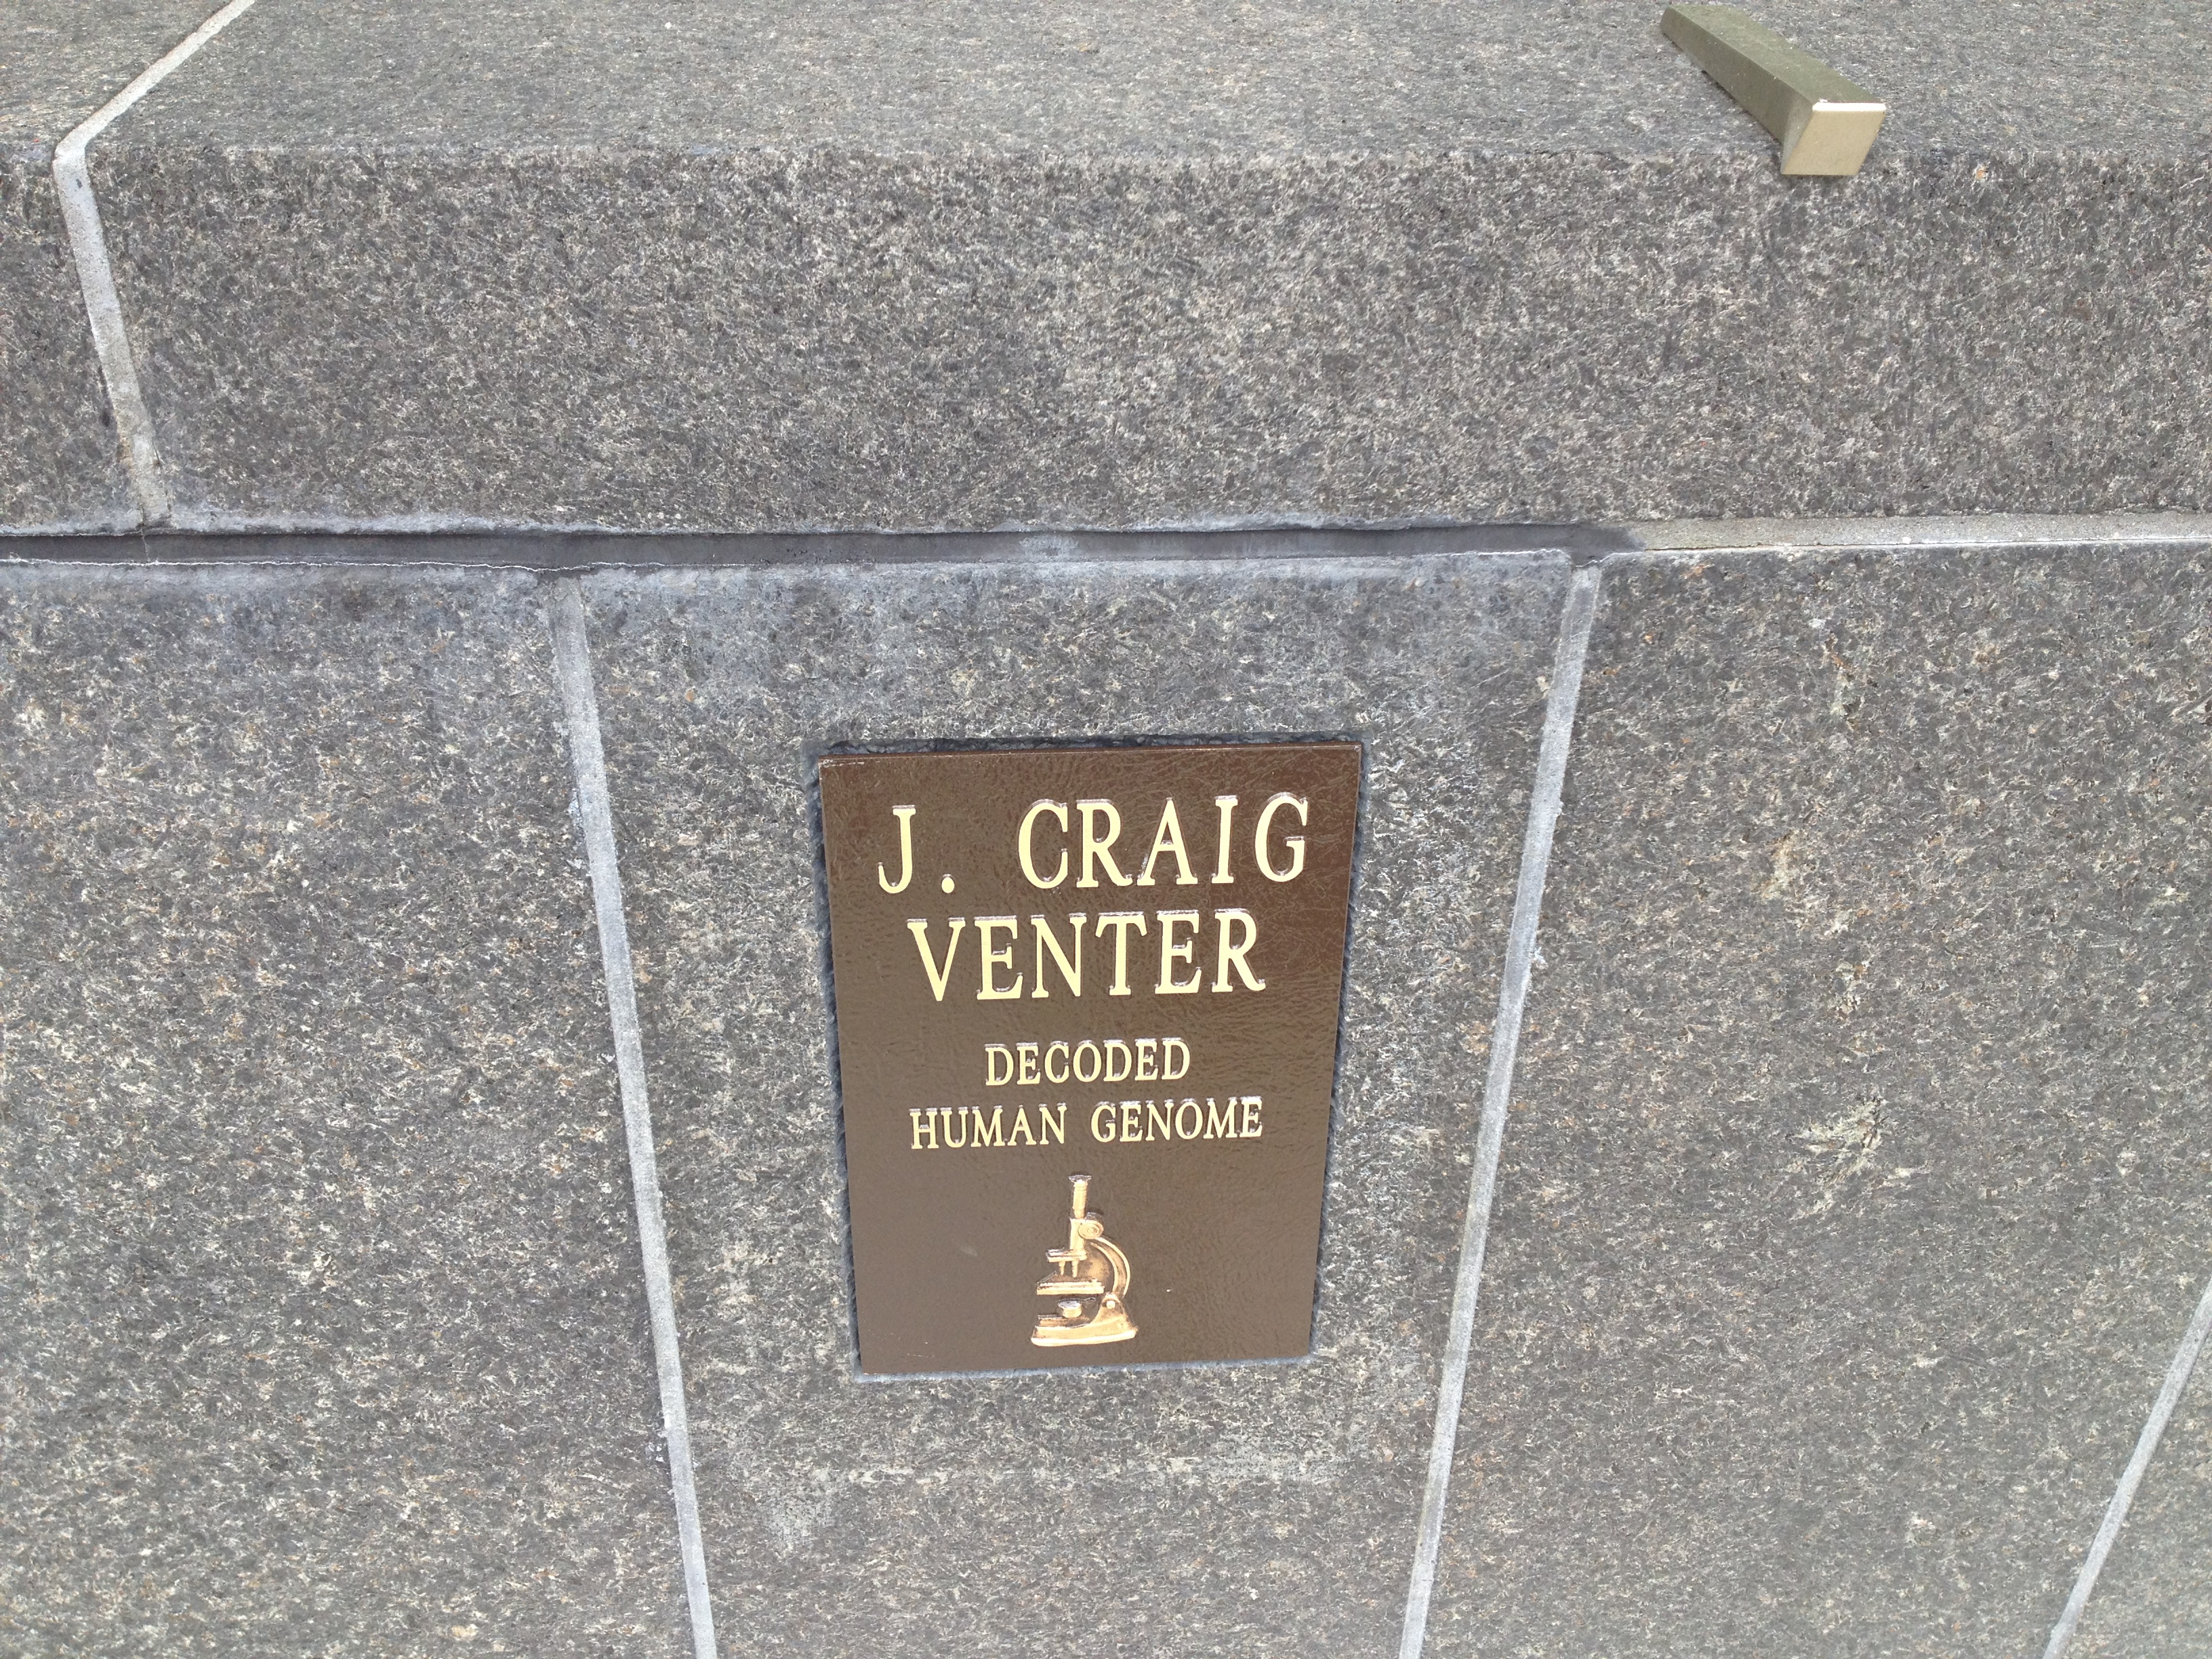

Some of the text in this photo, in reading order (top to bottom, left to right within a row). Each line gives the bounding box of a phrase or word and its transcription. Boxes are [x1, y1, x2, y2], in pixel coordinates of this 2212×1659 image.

[878, 792, 1309, 894] J. CRAIG
[906, 908, 1267, 1002] VENTER
[984, 1037, 1191, 1086] DECODED
[908, 1096, 1263, 1150] HUMAN GENOME
